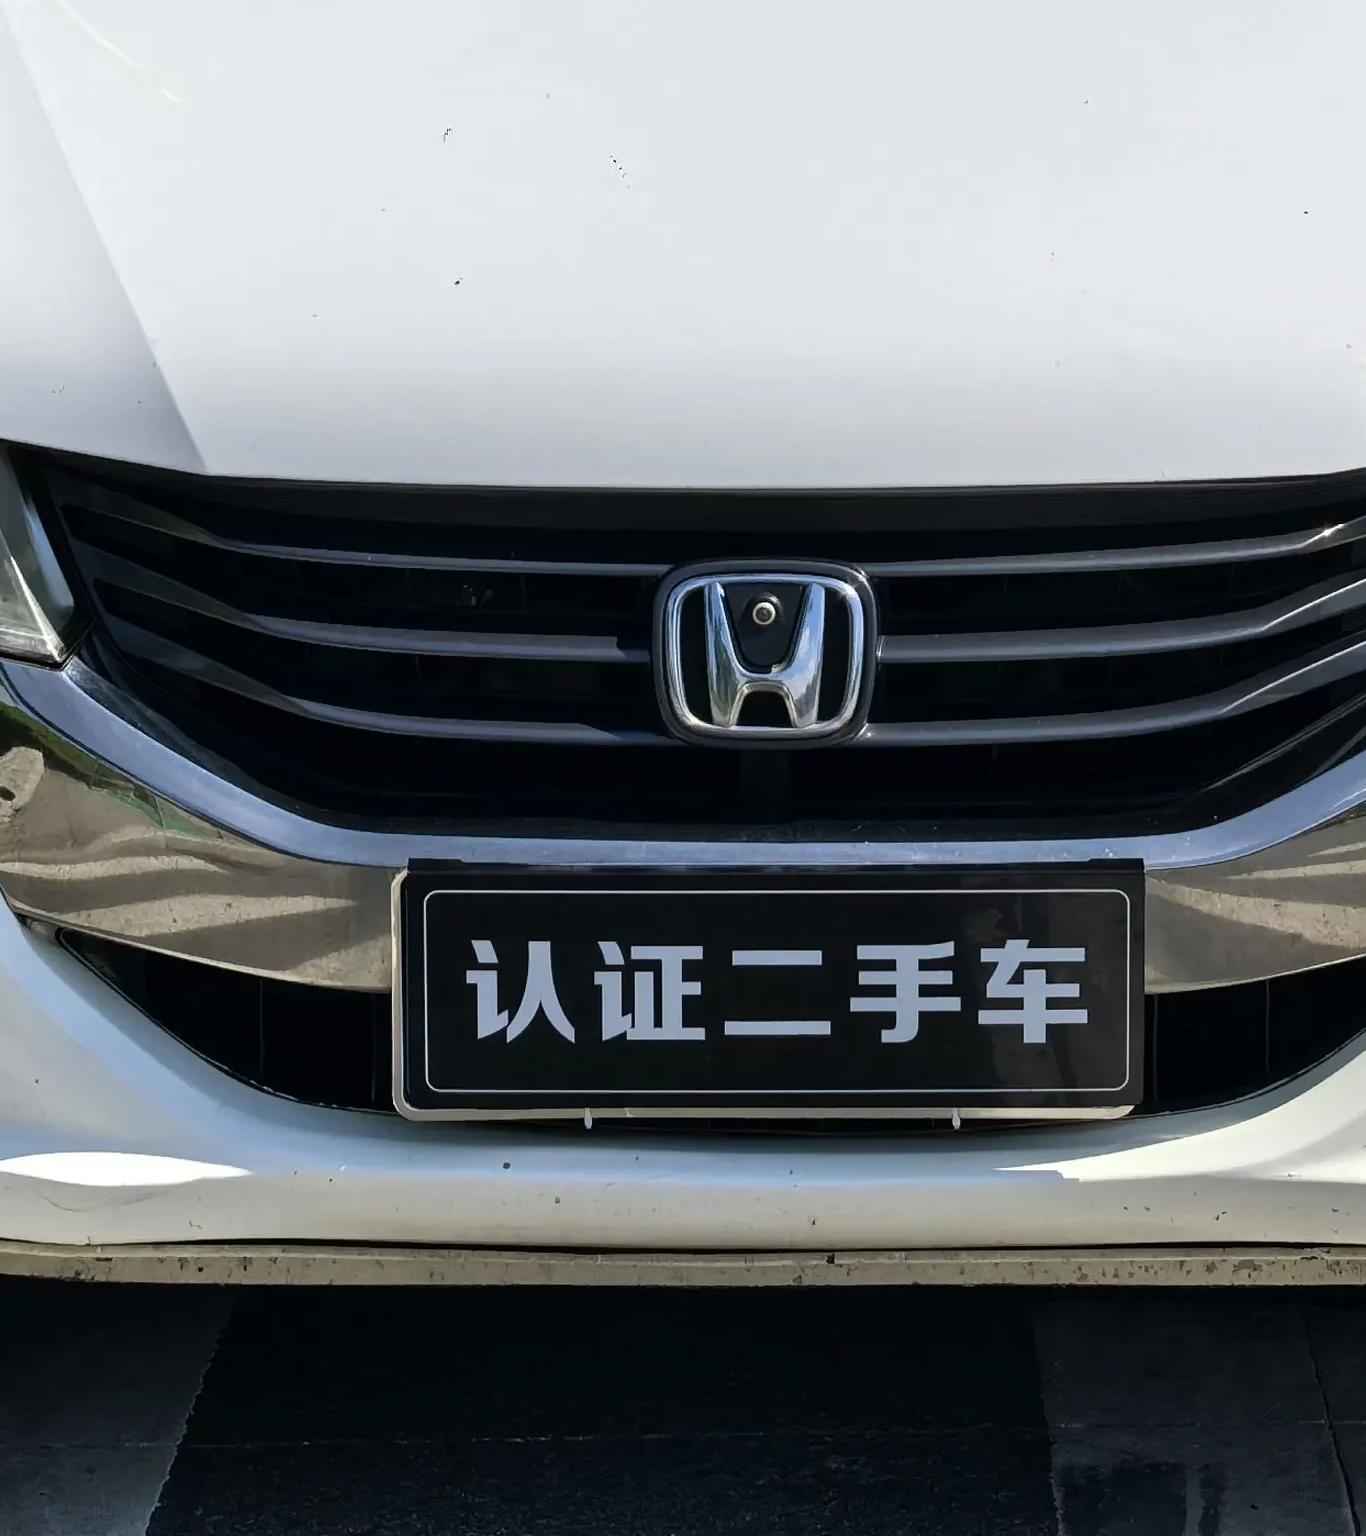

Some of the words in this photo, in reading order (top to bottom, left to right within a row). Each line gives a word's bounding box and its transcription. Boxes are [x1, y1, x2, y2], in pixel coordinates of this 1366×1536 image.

[467, 940, 1087, 1043] 认证二手车
